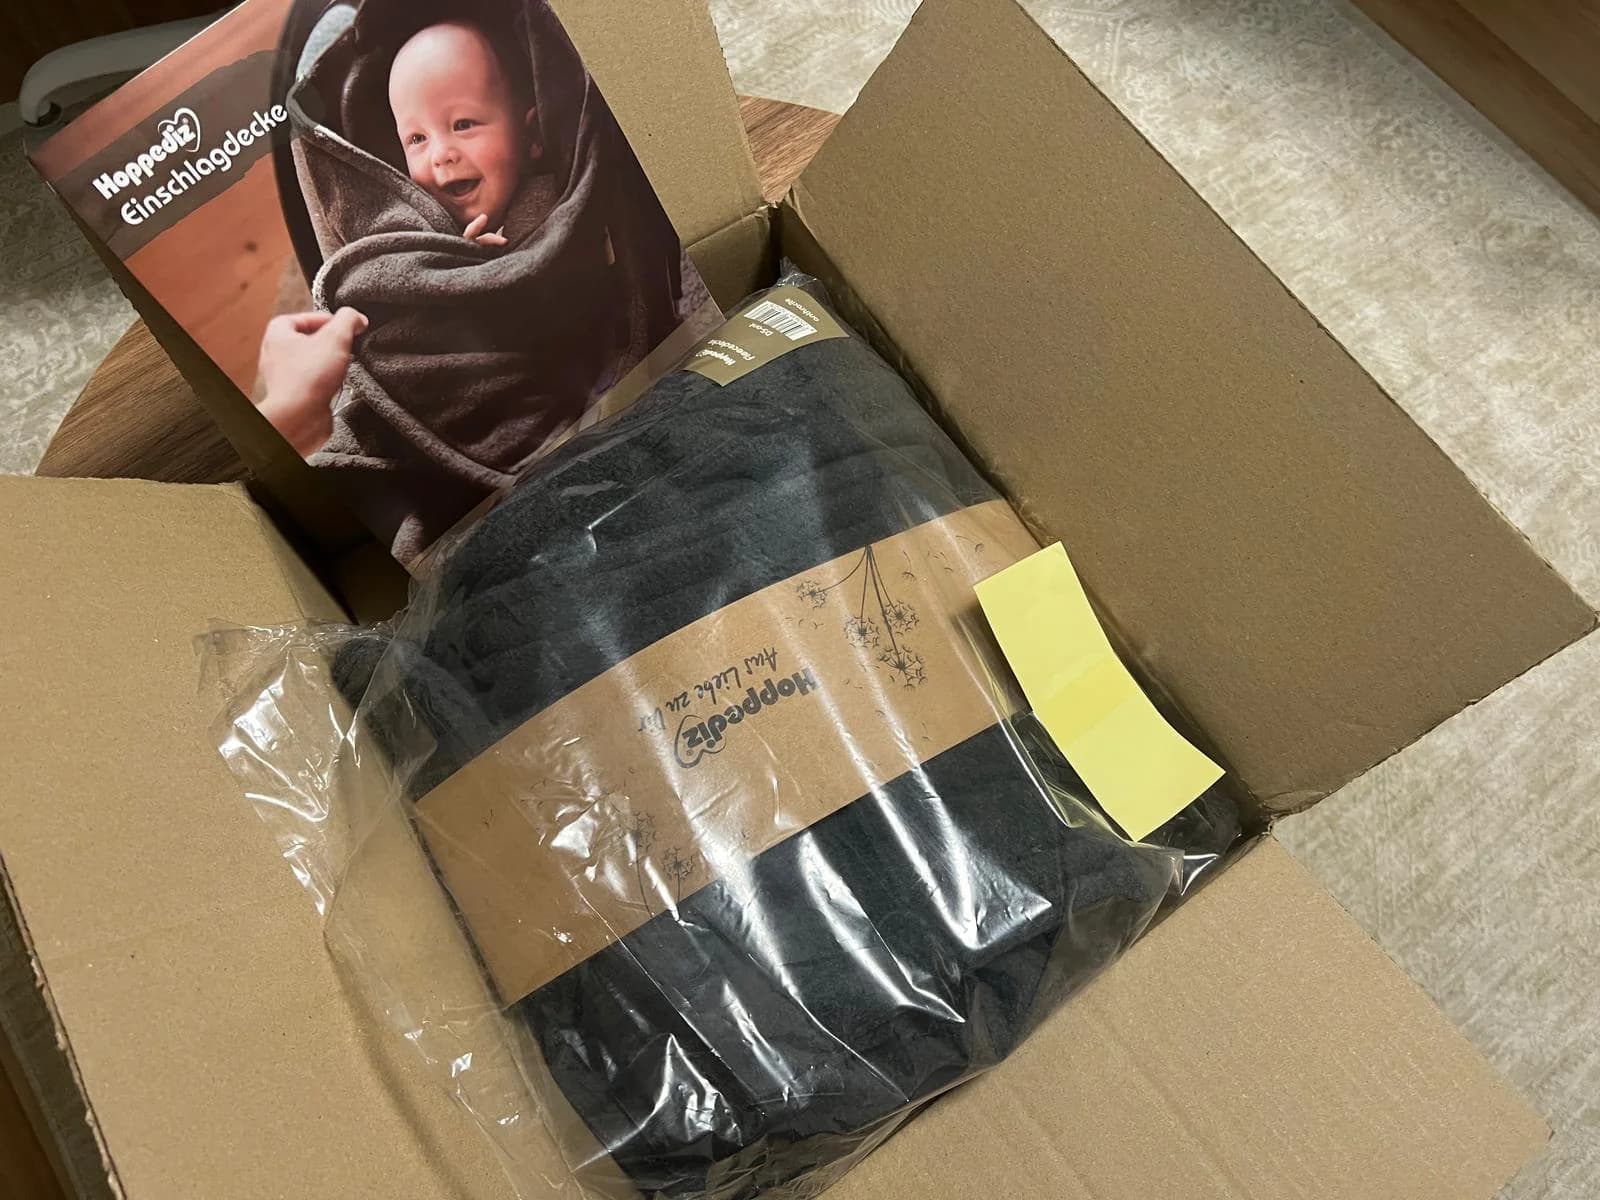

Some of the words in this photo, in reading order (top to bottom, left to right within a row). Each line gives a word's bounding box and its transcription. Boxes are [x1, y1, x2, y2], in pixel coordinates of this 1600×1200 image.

[92, 119, 197, 200] Hoppediz
[121, 104, 288, 225] Einschlagdecke
[694, 666, 742, 705] Liebe
[744, 647, 777, 675] Aus
[665, 691, 691, 712] zu
[681, 666, 818, 749] Hoppediz
